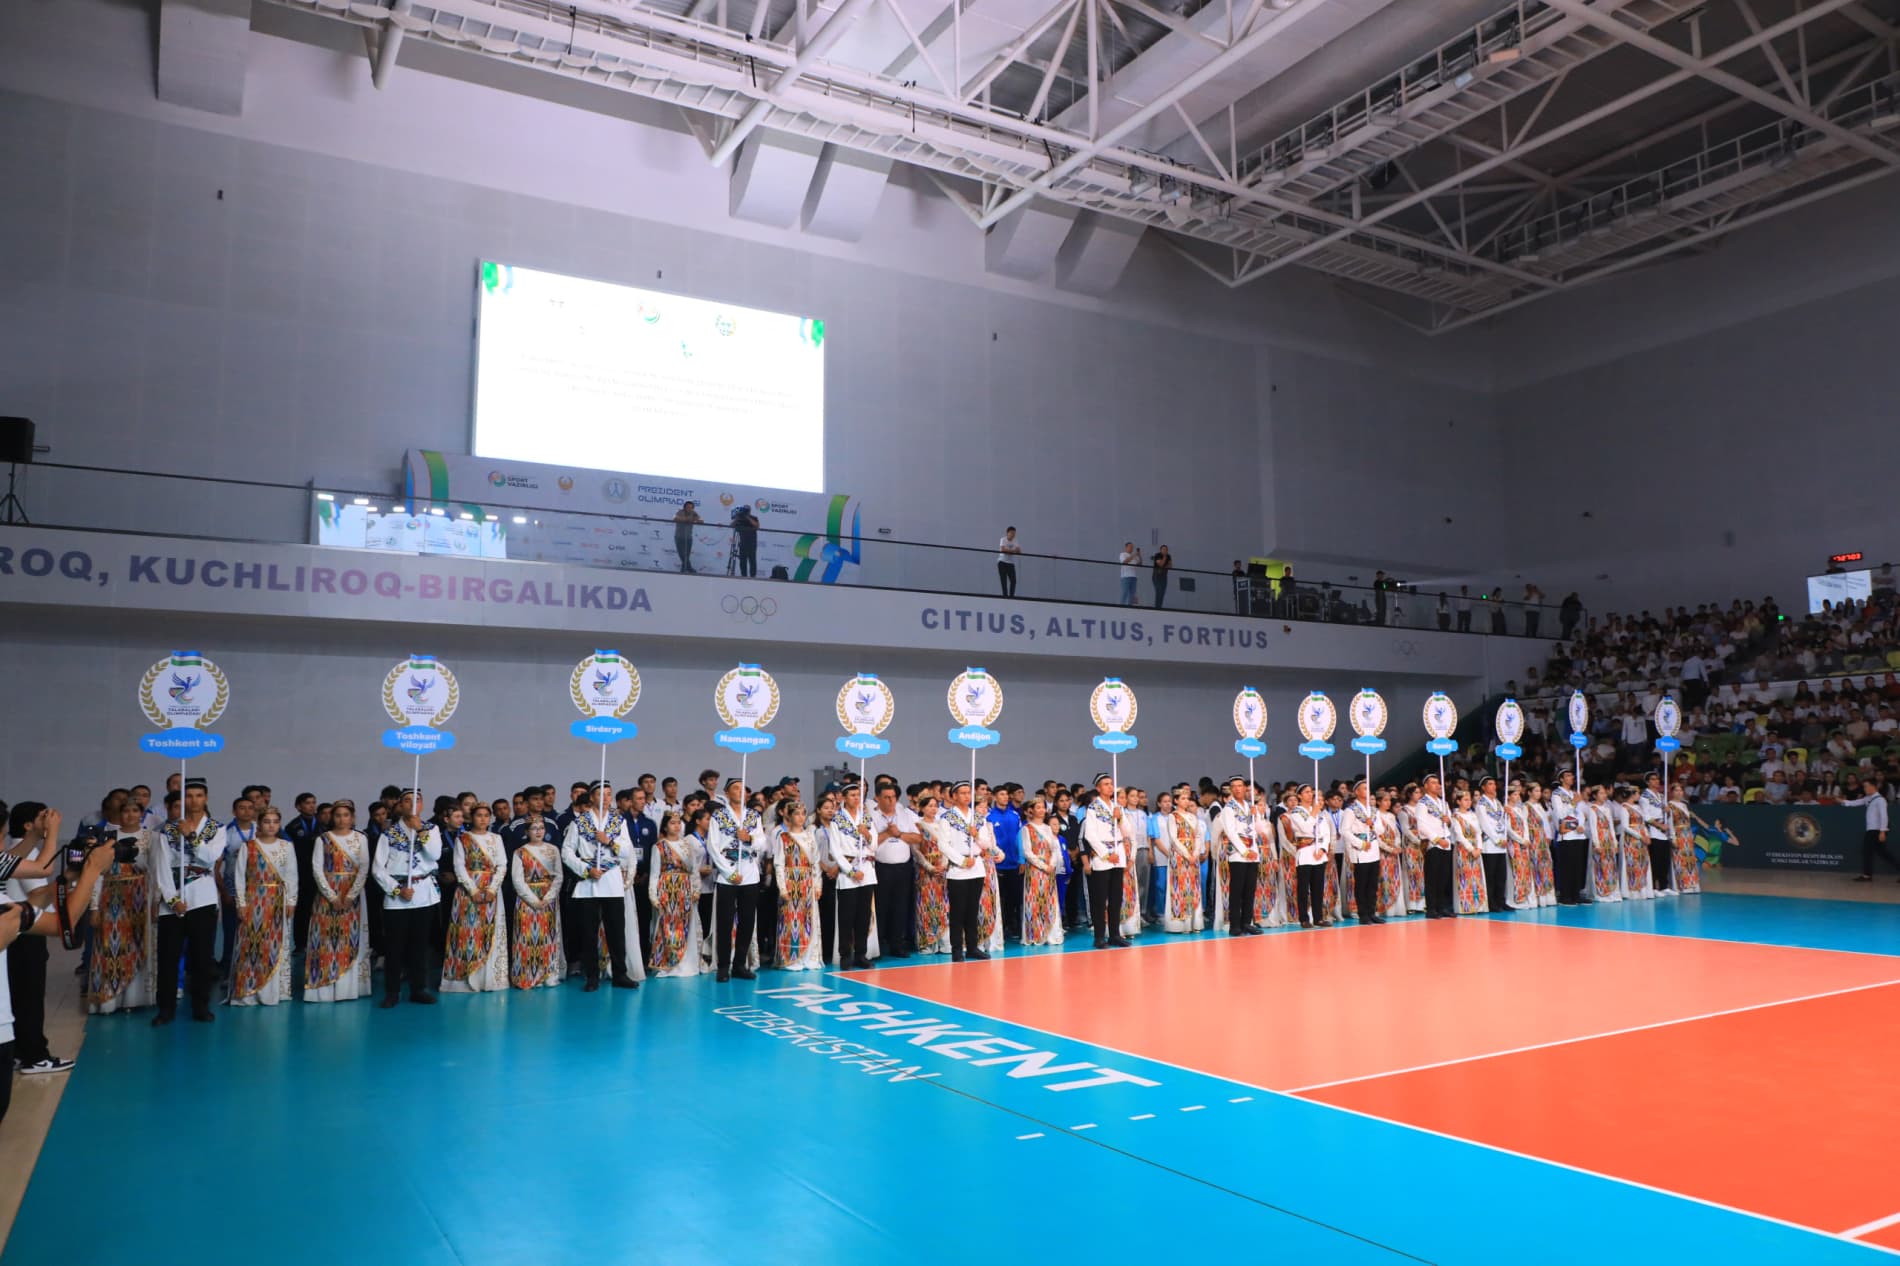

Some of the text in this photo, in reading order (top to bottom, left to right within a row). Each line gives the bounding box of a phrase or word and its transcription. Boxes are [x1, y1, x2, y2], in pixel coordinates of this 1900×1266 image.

[129, 554, 653, 612] KUCHLIROQ-BIRGALIKDA
[921, 607, 1268, 649] CITIUS, ALTIUS, FORTIUS
[148, 739, 217, 748] Toshkent sh
[397, 732, 441, 740] Toshkent
[720, 735, 770, 745] Namangan
[959, 732, 991, 742] Andijon
[712, 1005, 942, 1083] UZBEKISTAN
[754, 982, 1162, 1092] TASHKENT
